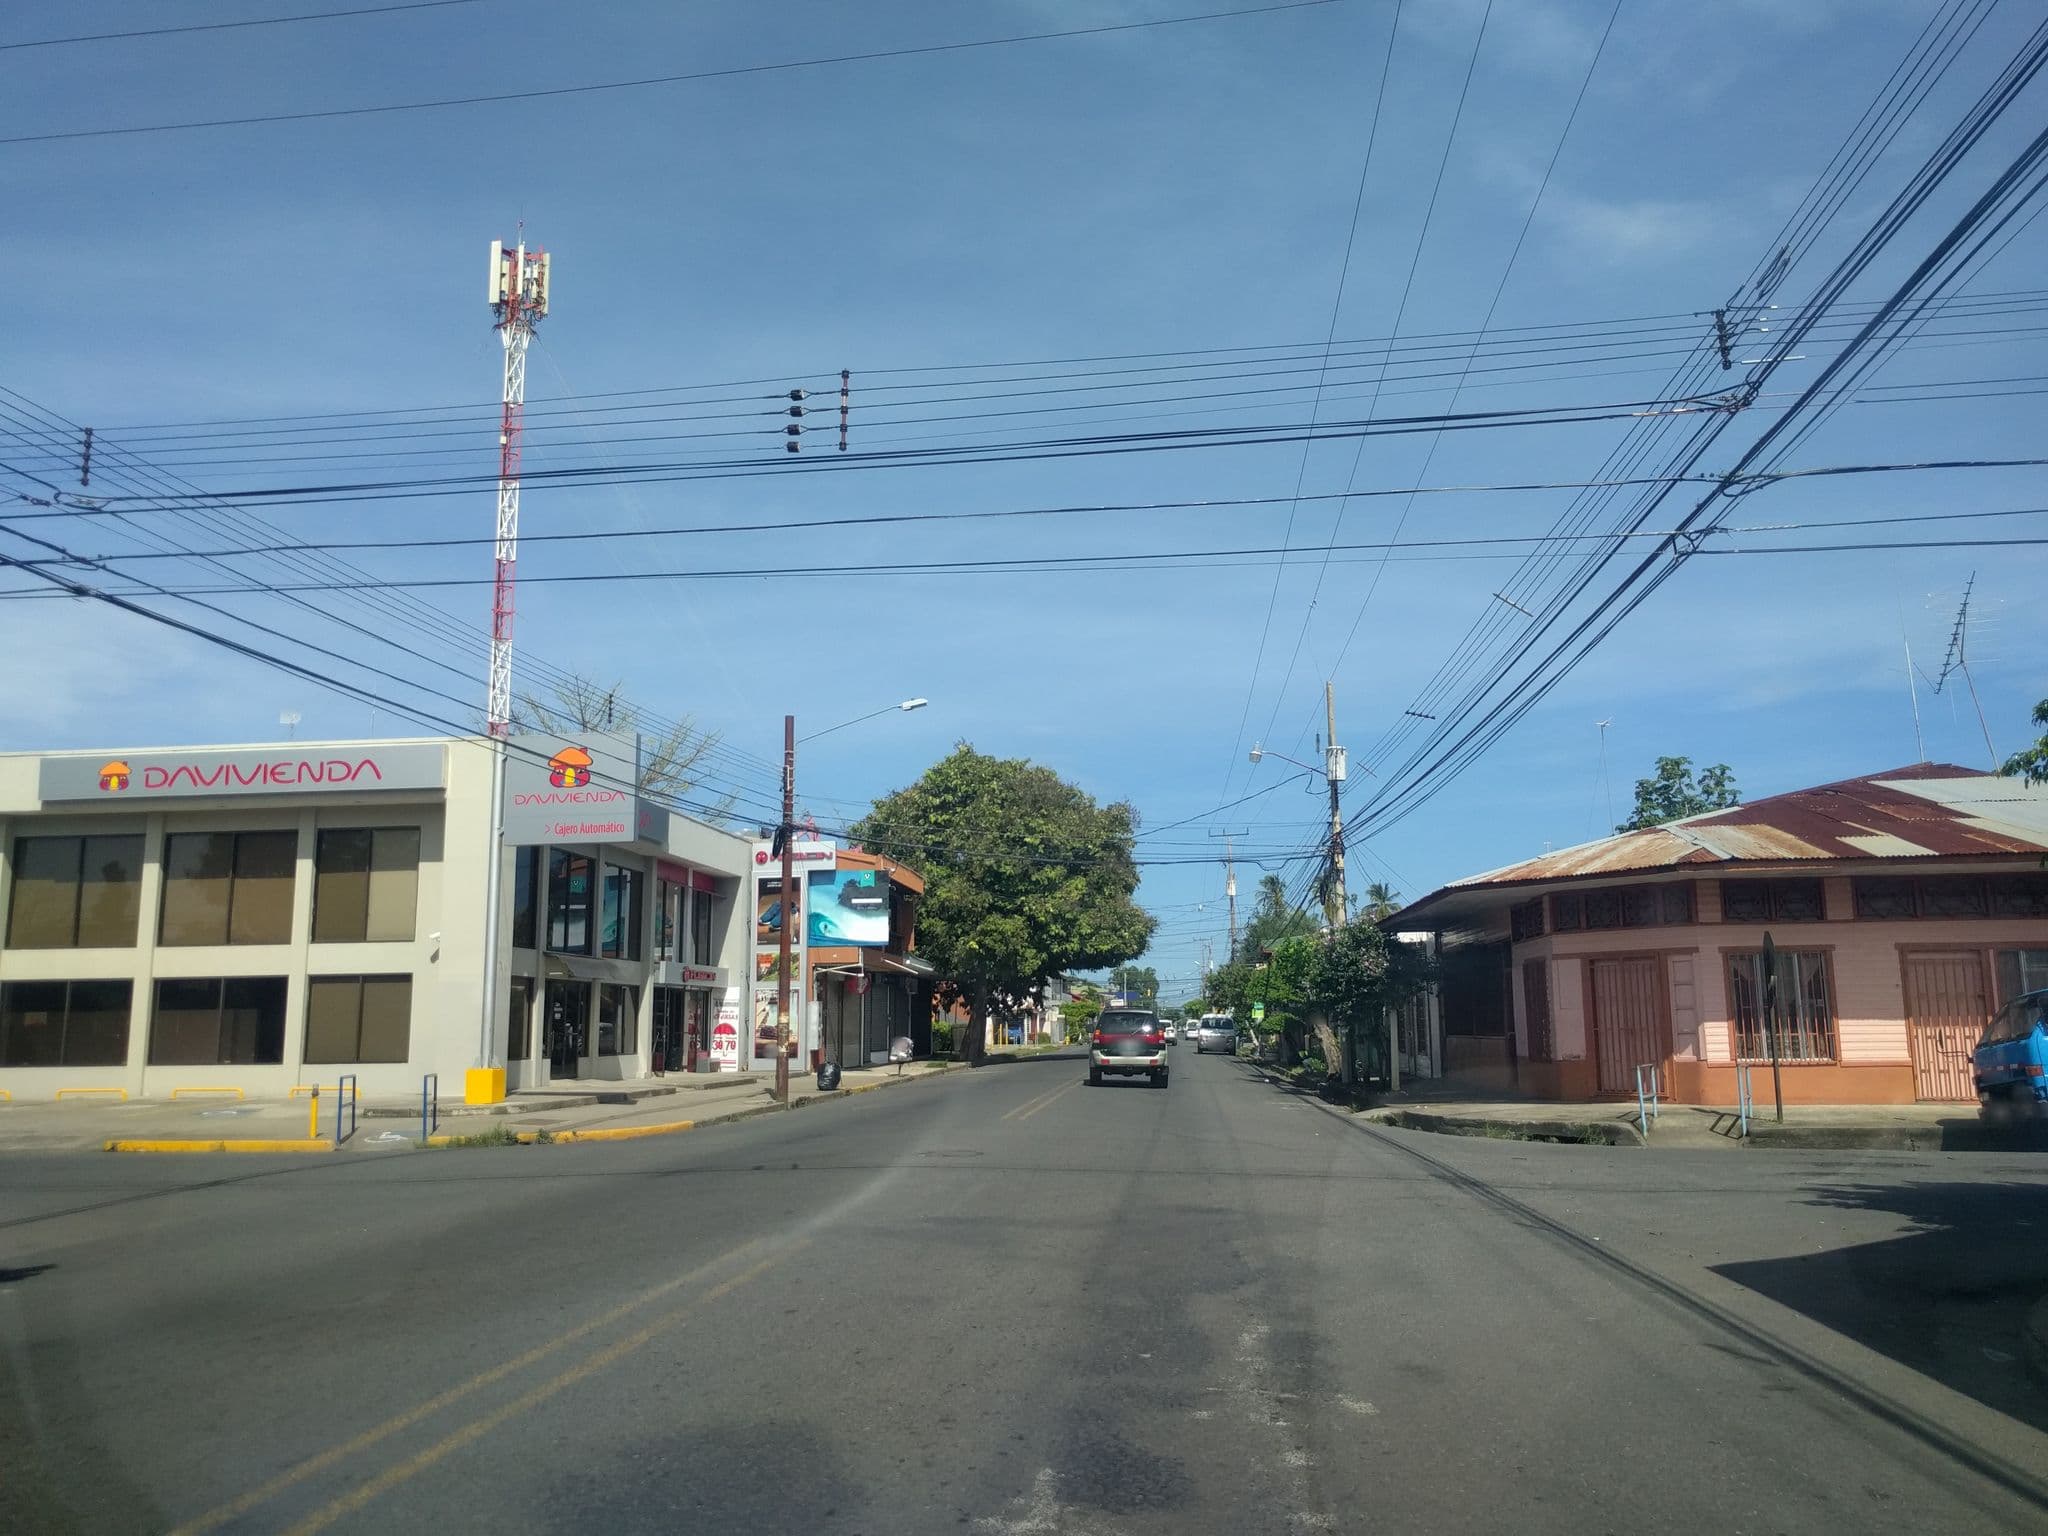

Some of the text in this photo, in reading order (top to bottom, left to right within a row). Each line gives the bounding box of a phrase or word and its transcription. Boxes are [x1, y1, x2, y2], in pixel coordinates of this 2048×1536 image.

[144, 759, 381, 788] DAVIVIENDA
[515, 791, 626, 805] DAVIVIENDA
[554, 822, 578, 837] Cajero
[579, 819, 625, 834] Automático
